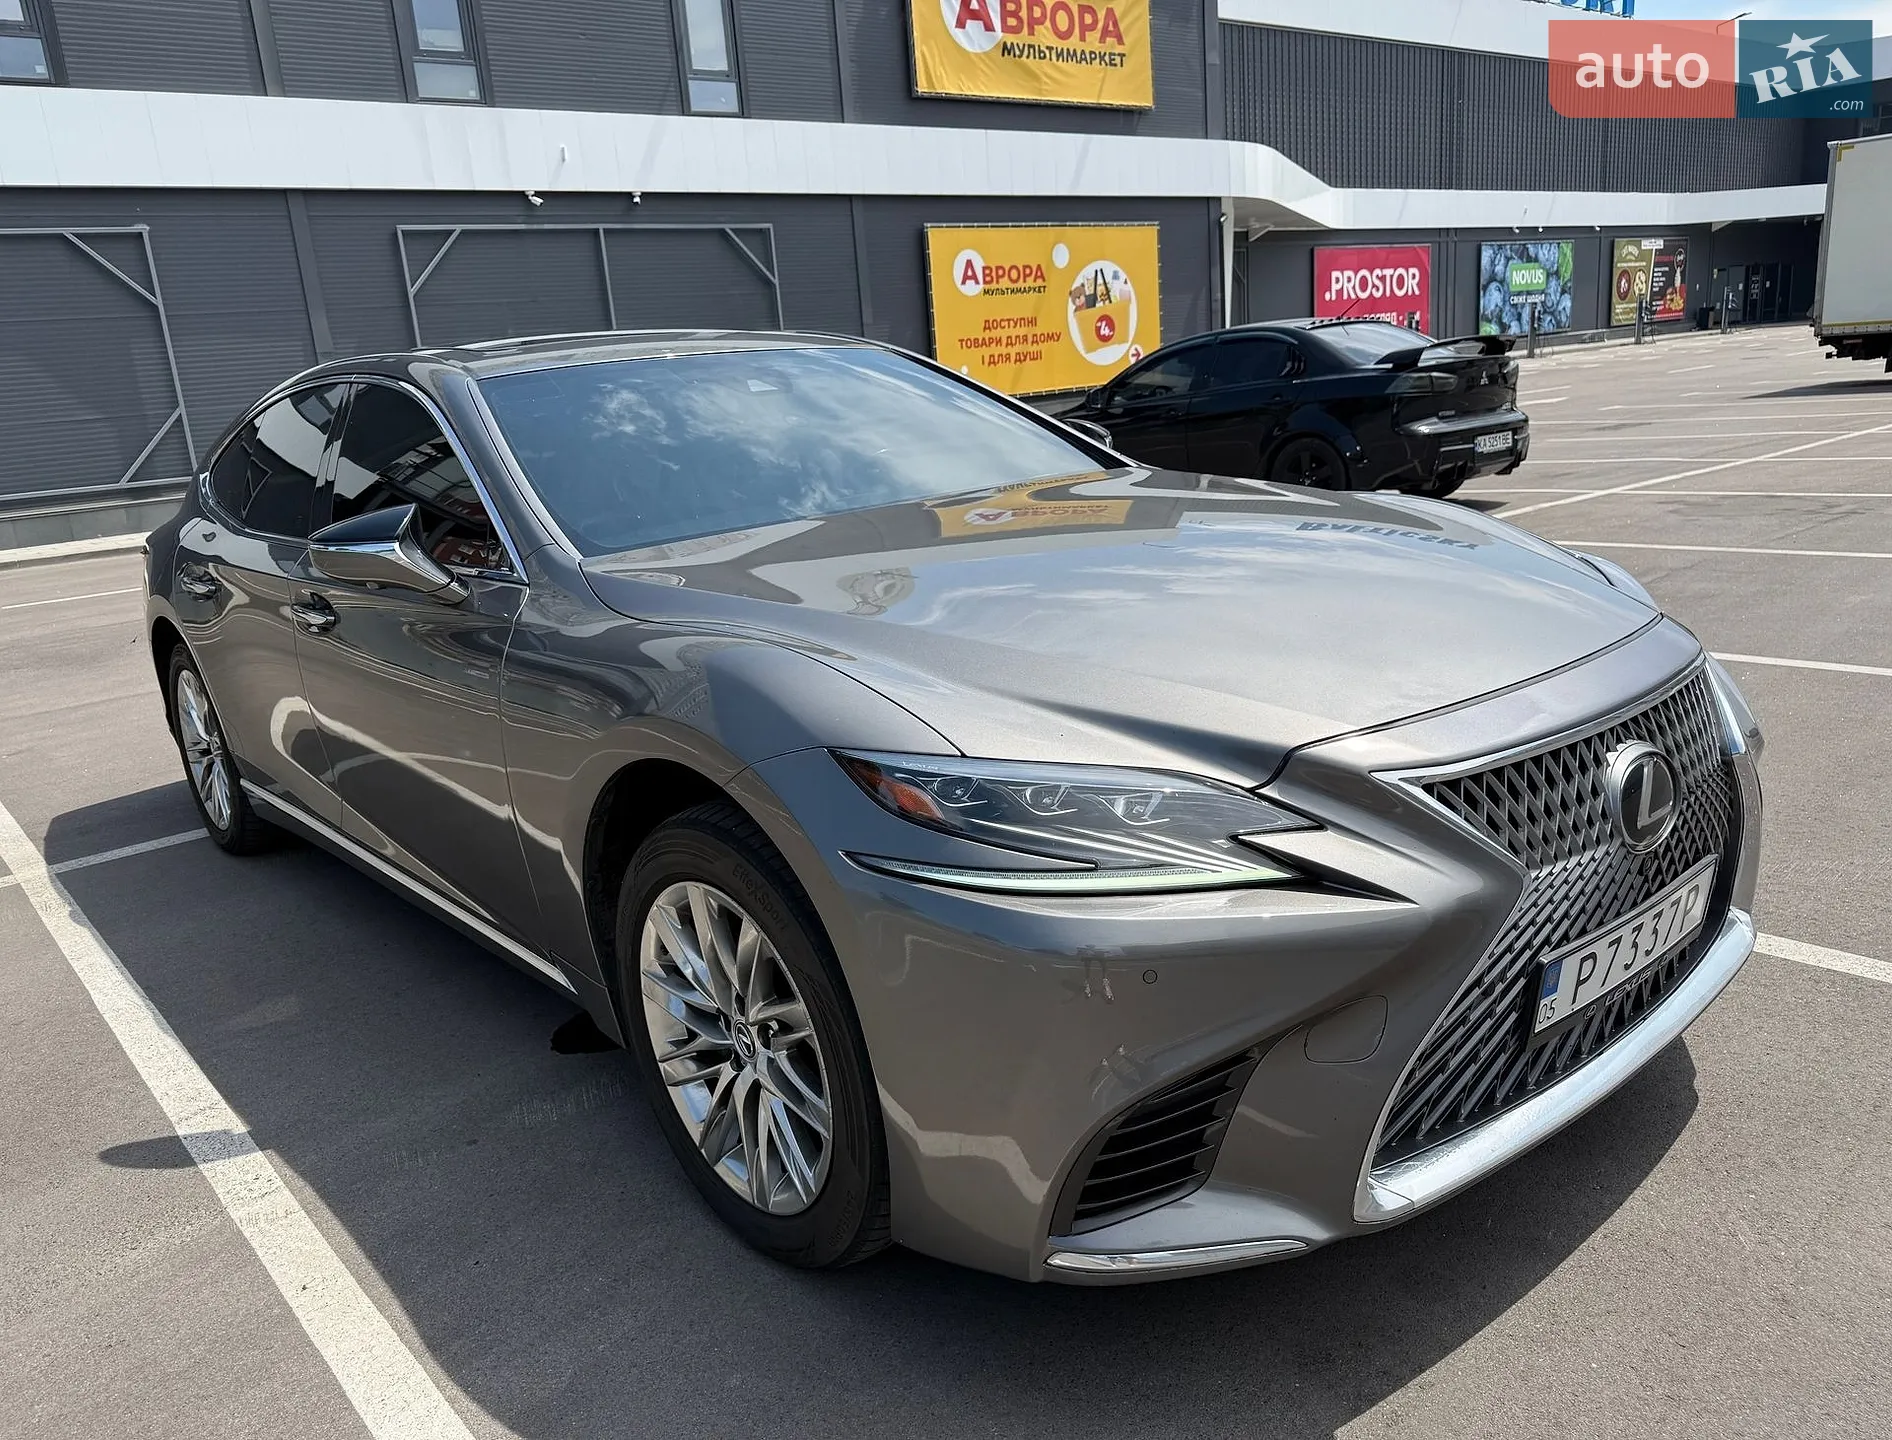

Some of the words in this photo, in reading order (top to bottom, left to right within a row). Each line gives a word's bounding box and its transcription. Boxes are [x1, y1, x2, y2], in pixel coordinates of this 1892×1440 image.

[954, 0, 1126, 46] АВРОРА
[1001, 41, 1127, 68] МУЛЬТИМАРКЕТ
[960, 258, 1046, 286] АВРОРА
[1512, 268, 1545, 285] NOVUS
[982, 285, 1047, 297] МУЛЬТИМАРКЕТ
[982, 316, 1038, 333] ДОСТУПНІ
[958, 336, 1003, 350] ТОВАРИ
[1005, 334, 1029, 348] ДЛЯ
[1030, 331, 1062, 345] ДОМУ
[987, 352, 1011, 367] ДЛЯ
[1013, 350, 1043, 365] ДУШІ
[1571, 884, 1700, 1005] P7337P
[1538, 998, 1557, 1024] 05
